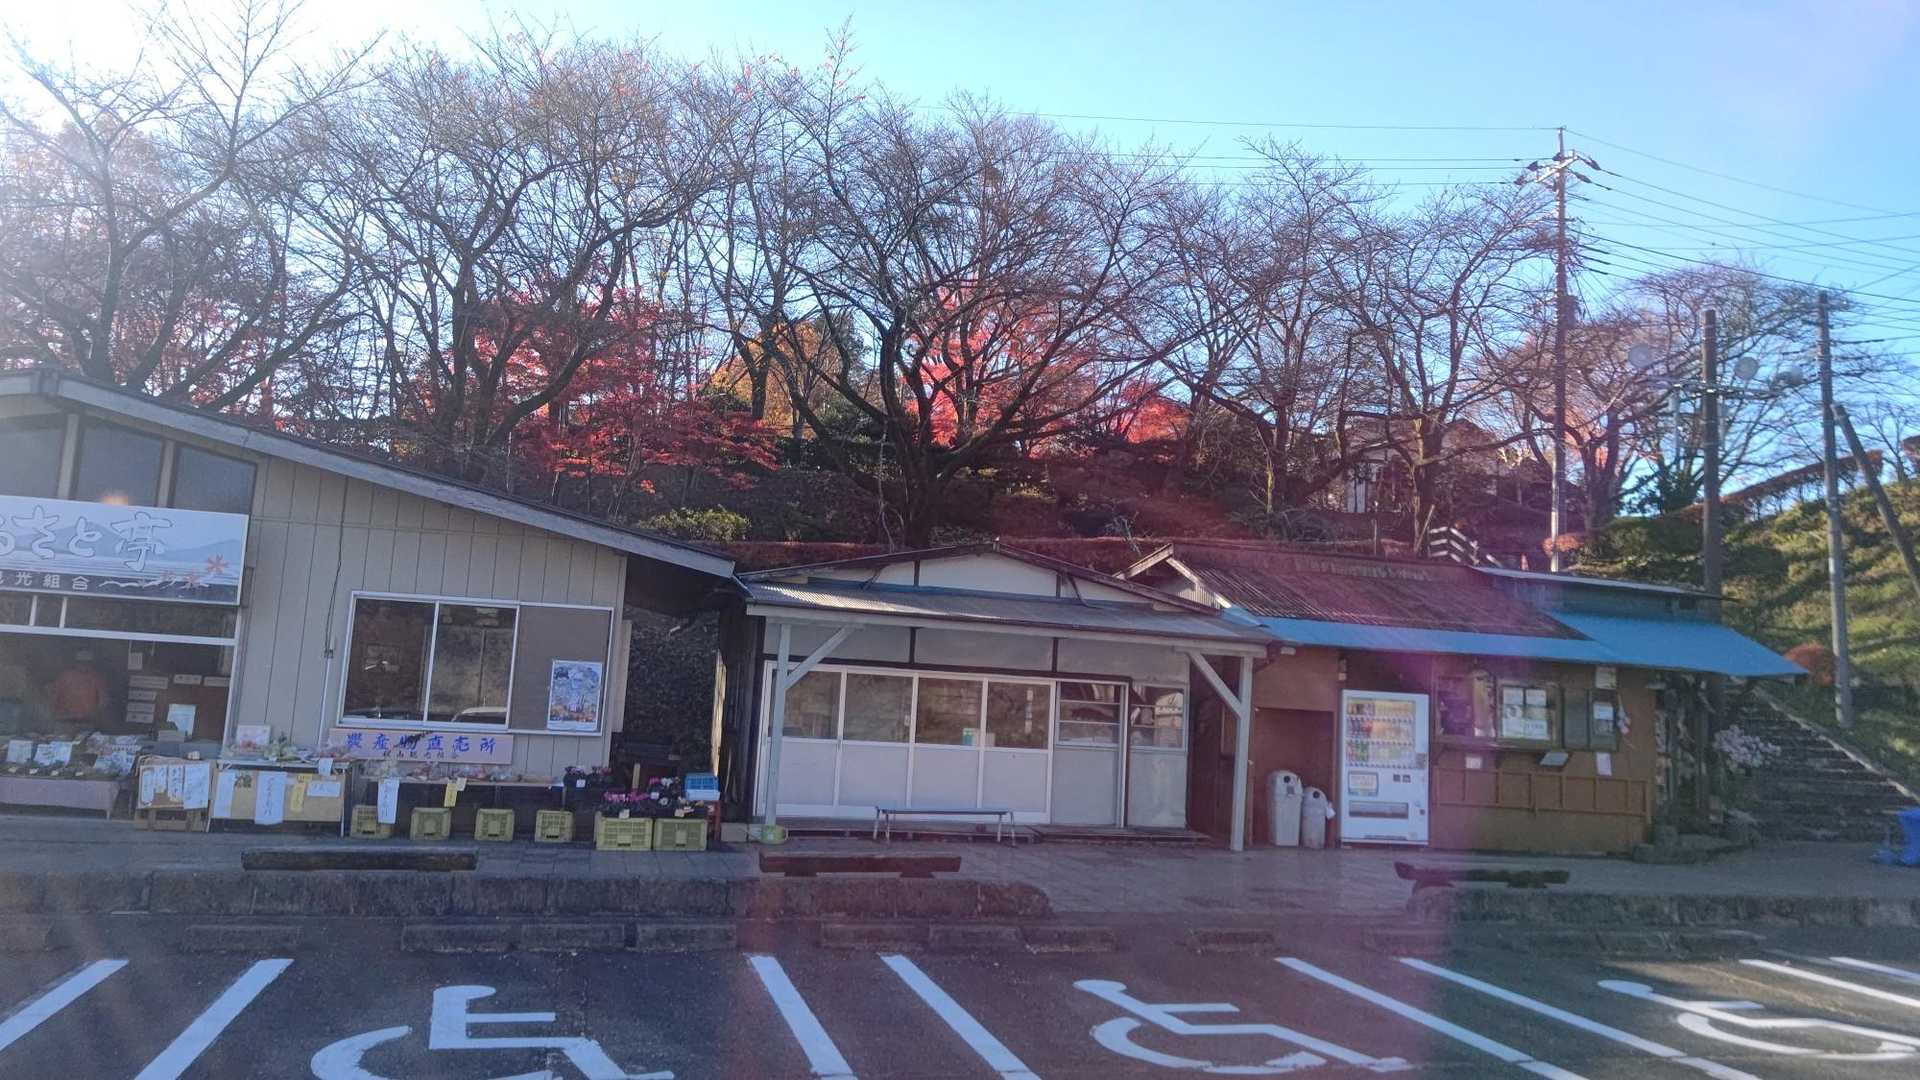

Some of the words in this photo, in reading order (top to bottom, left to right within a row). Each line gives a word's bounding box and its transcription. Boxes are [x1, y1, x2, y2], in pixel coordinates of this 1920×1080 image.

[0, 570, 90, 592] 光組合
[347, 732, 497, 753] 農産物直売所
